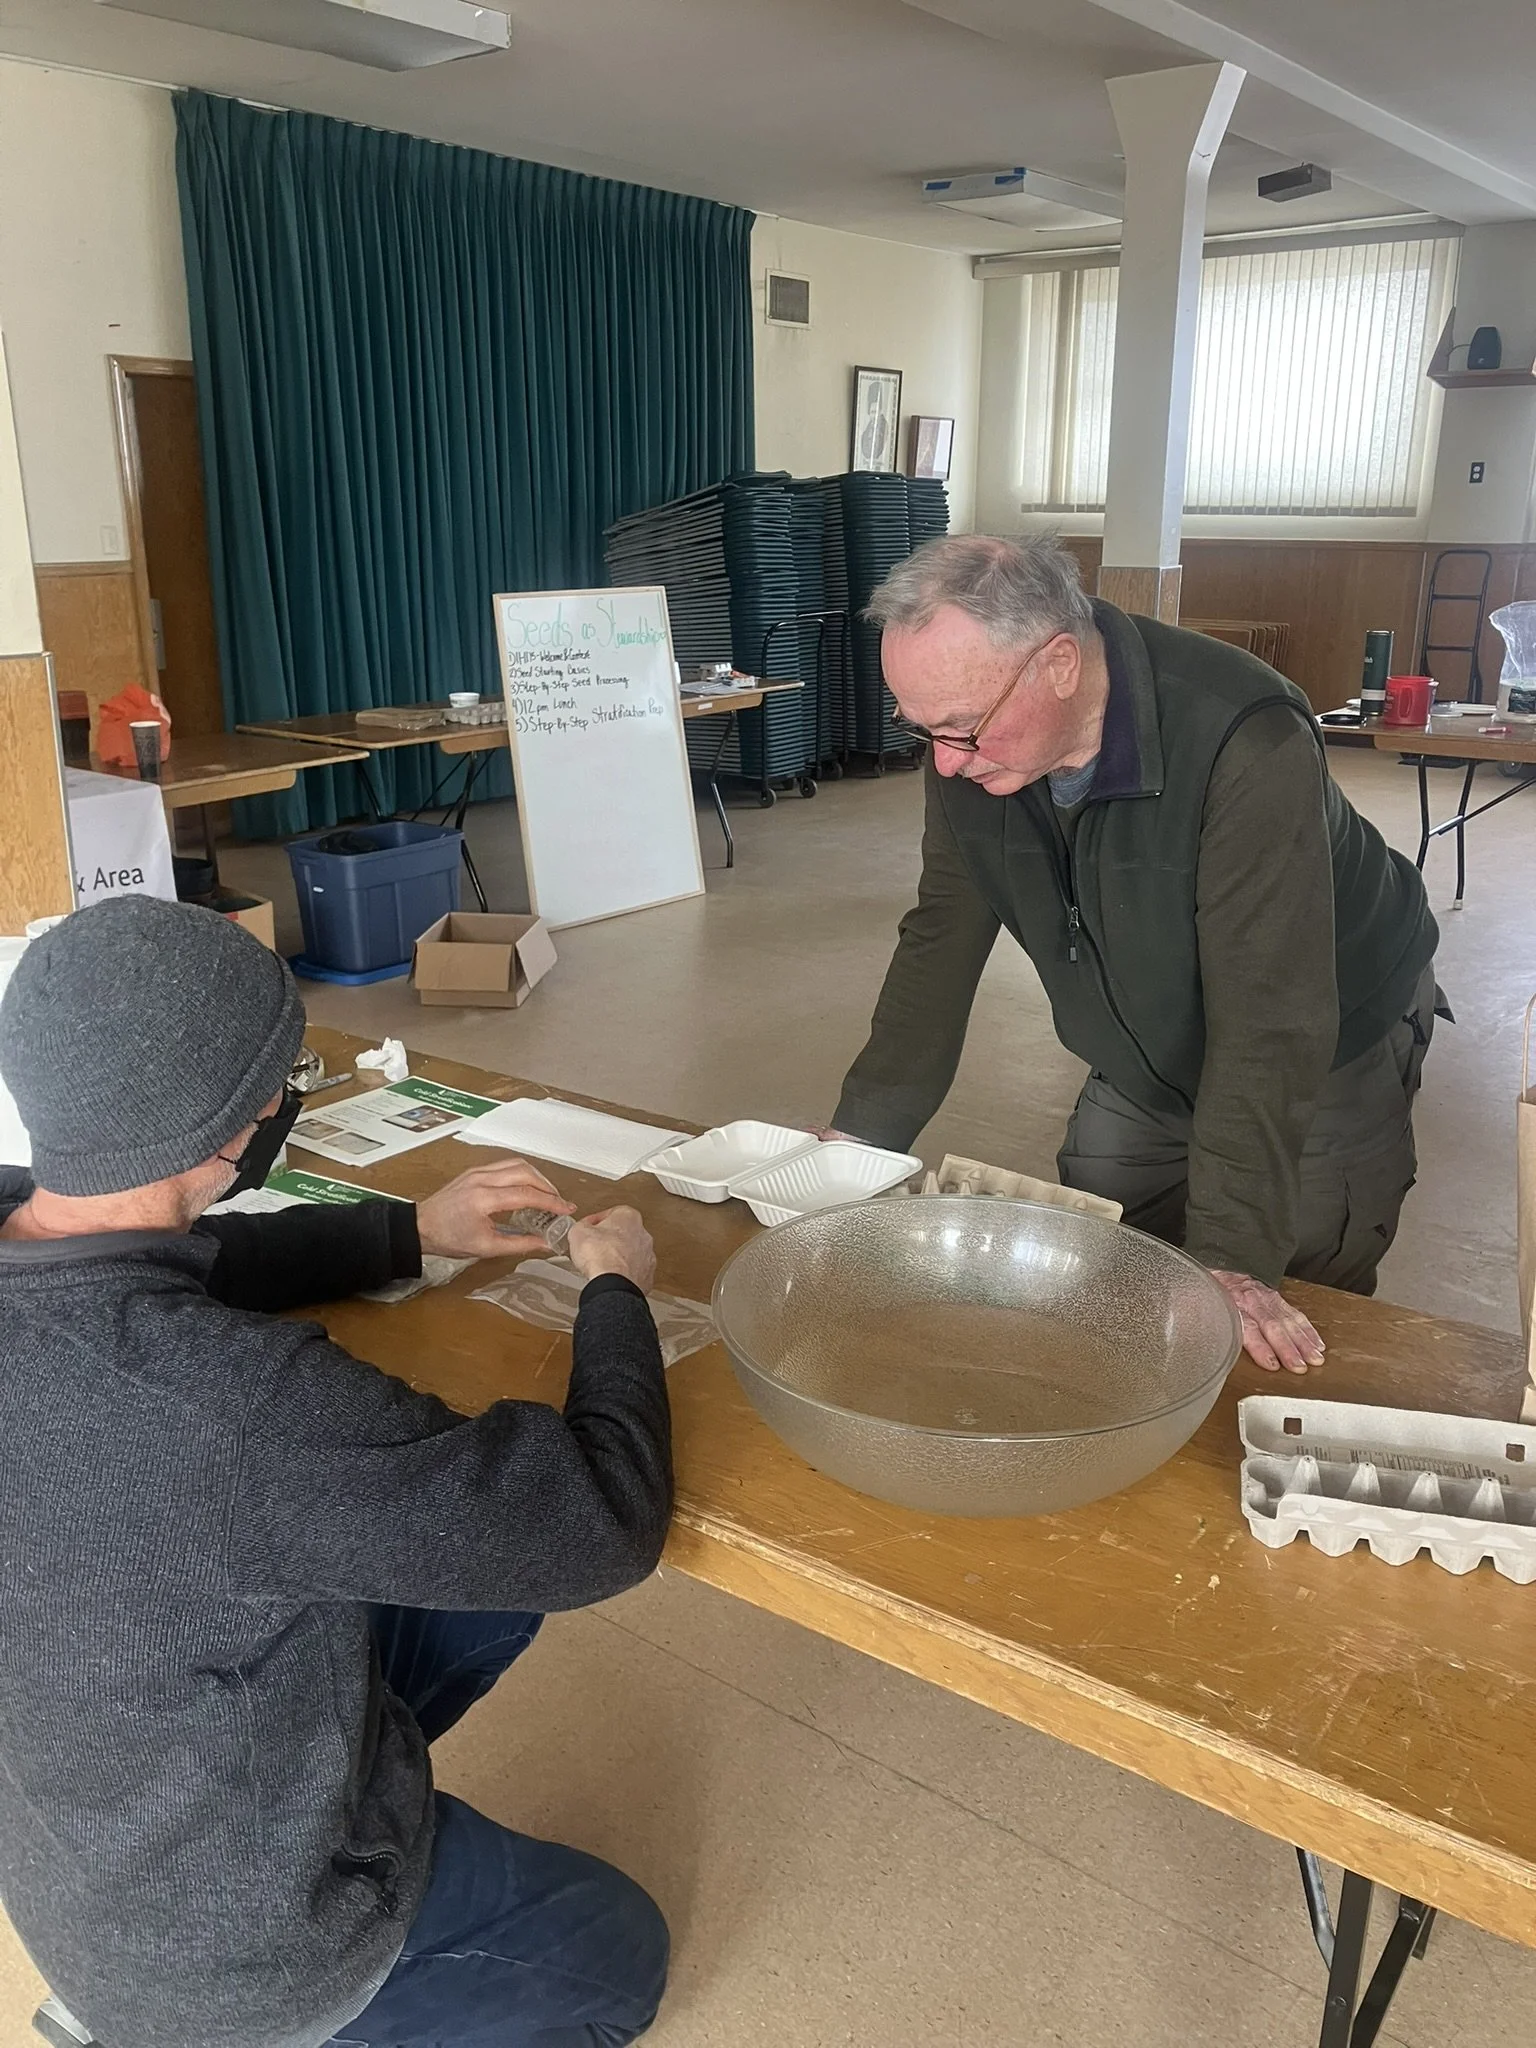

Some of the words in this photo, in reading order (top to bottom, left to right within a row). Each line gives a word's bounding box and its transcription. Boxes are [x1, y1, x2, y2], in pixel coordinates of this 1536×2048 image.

[507, 602, 573, 649] Seeds
[582, 622, 596, 640] as
[534, 666, 563, 680] Starting
[571, 677, 592, 687] Seed
[596, 675, 629, 689] Processing
[553, 697, 577, 708] Lunch
[93, 867, 145, 890] Area
